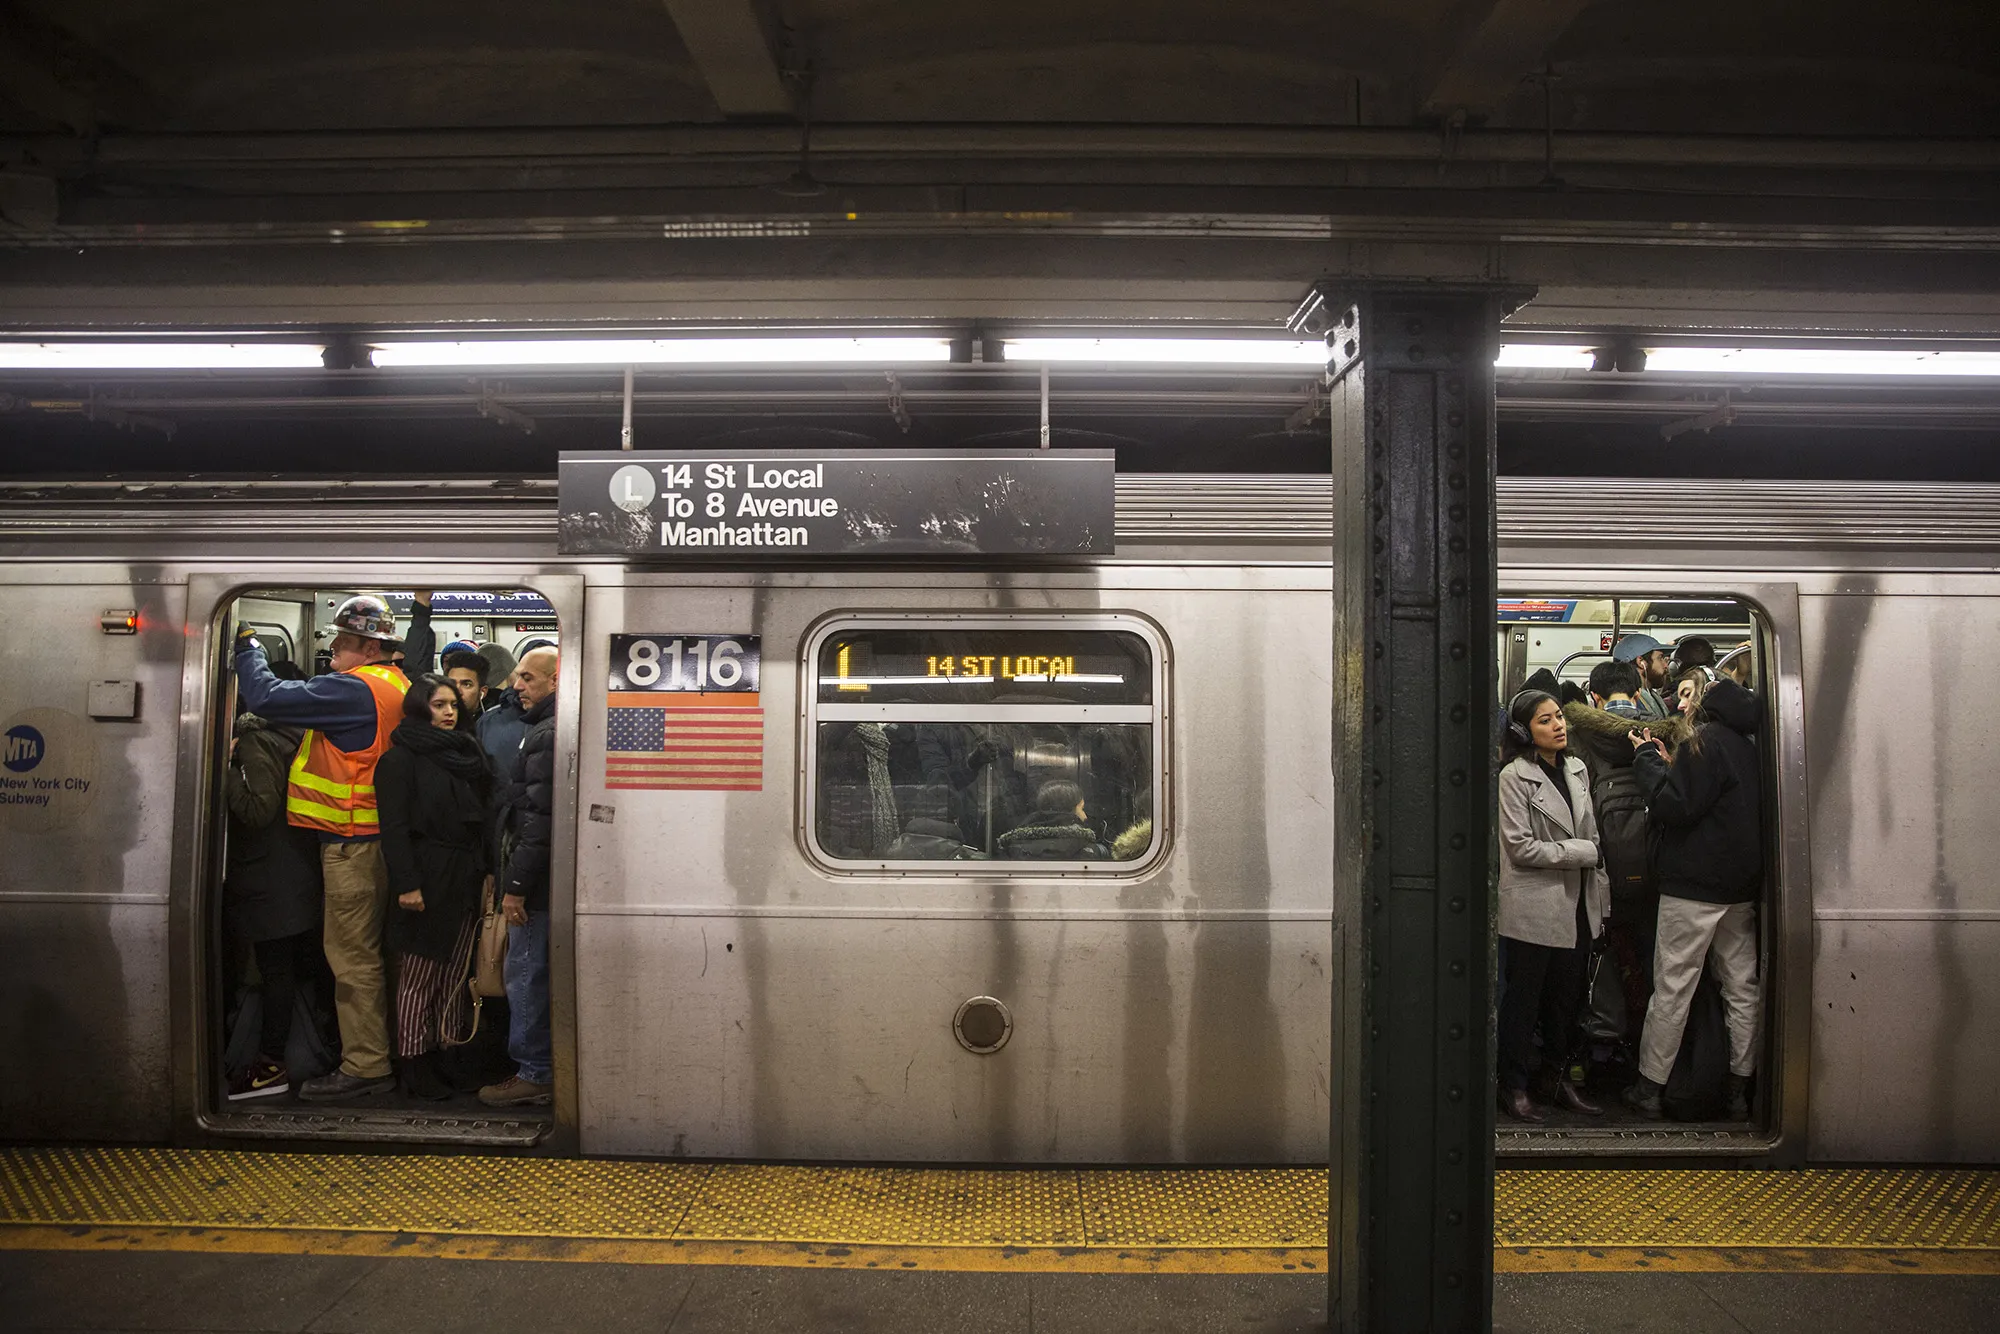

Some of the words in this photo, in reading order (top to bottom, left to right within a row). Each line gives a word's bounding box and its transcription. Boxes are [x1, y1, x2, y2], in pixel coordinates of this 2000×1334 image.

[623, 475, 644, 503] L
[661, 464, 693, 489] 14
[704, 464, 736, 489] St
[747, 464, 824, 489] Local
[661, 492, 694, 518] To
[706, 492, 726, 518] 8
[736, 492, 838, 518] Avenue
[661, 521, 808, 546] Manhattan
[1515, 634, 1525, 642] R4
[627, 640, 743, 687] 8116
[838, 642, 871, 691] L
[927, 656, 954, 677] 14
[962, 656, 996, 677] ST
[1002, 656, 1079, 678] LOCAL
[3, 735, 38, 763] MTA
[0, 777, 28, 790] New
[33, 777, 60, 790] York
[65, 777, 91, 793] City
[0, 792, 50, 808] Subway
